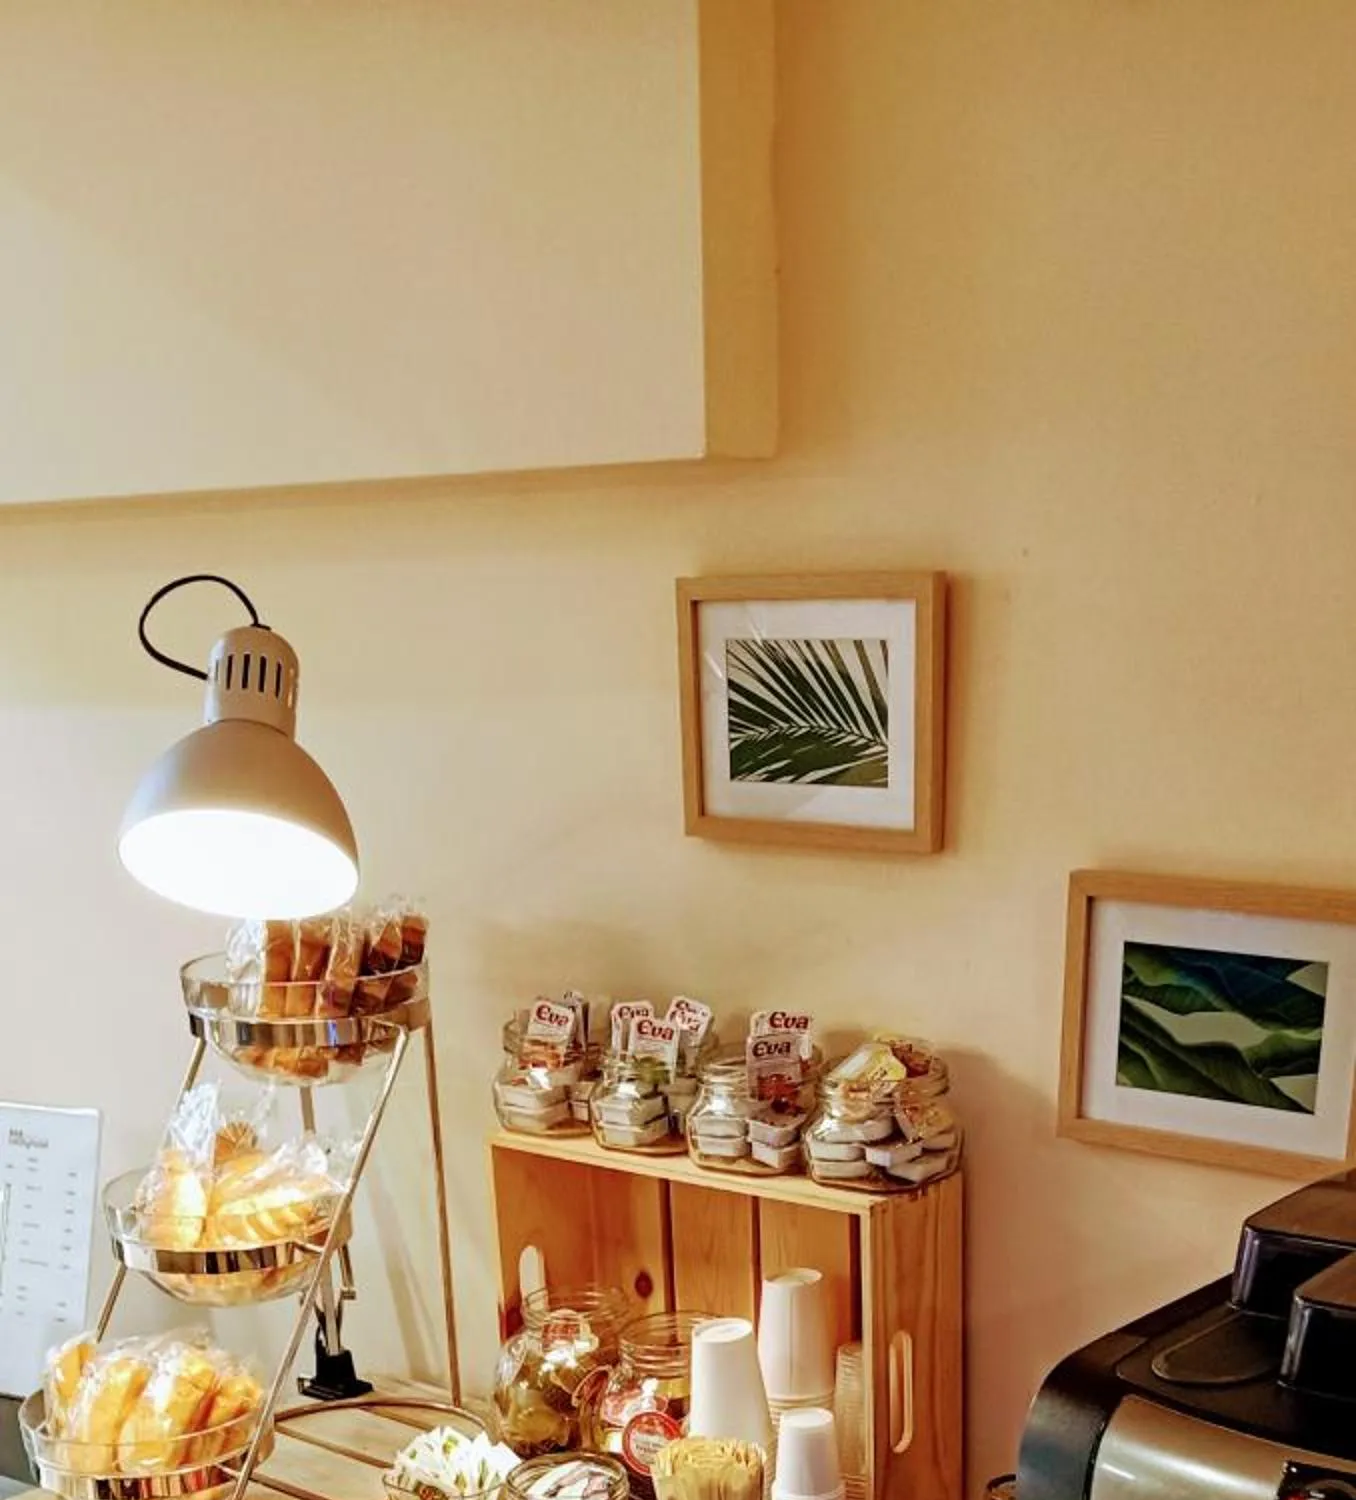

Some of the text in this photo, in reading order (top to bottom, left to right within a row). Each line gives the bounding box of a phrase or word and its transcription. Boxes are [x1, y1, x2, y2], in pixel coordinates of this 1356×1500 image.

[536, 1004, 569, 1026] Eva
[769, 1011, 809, 1030] Eva
[637, 1019, 675, 1041] Eva
[752, 1041, 792, 1058] Eva
